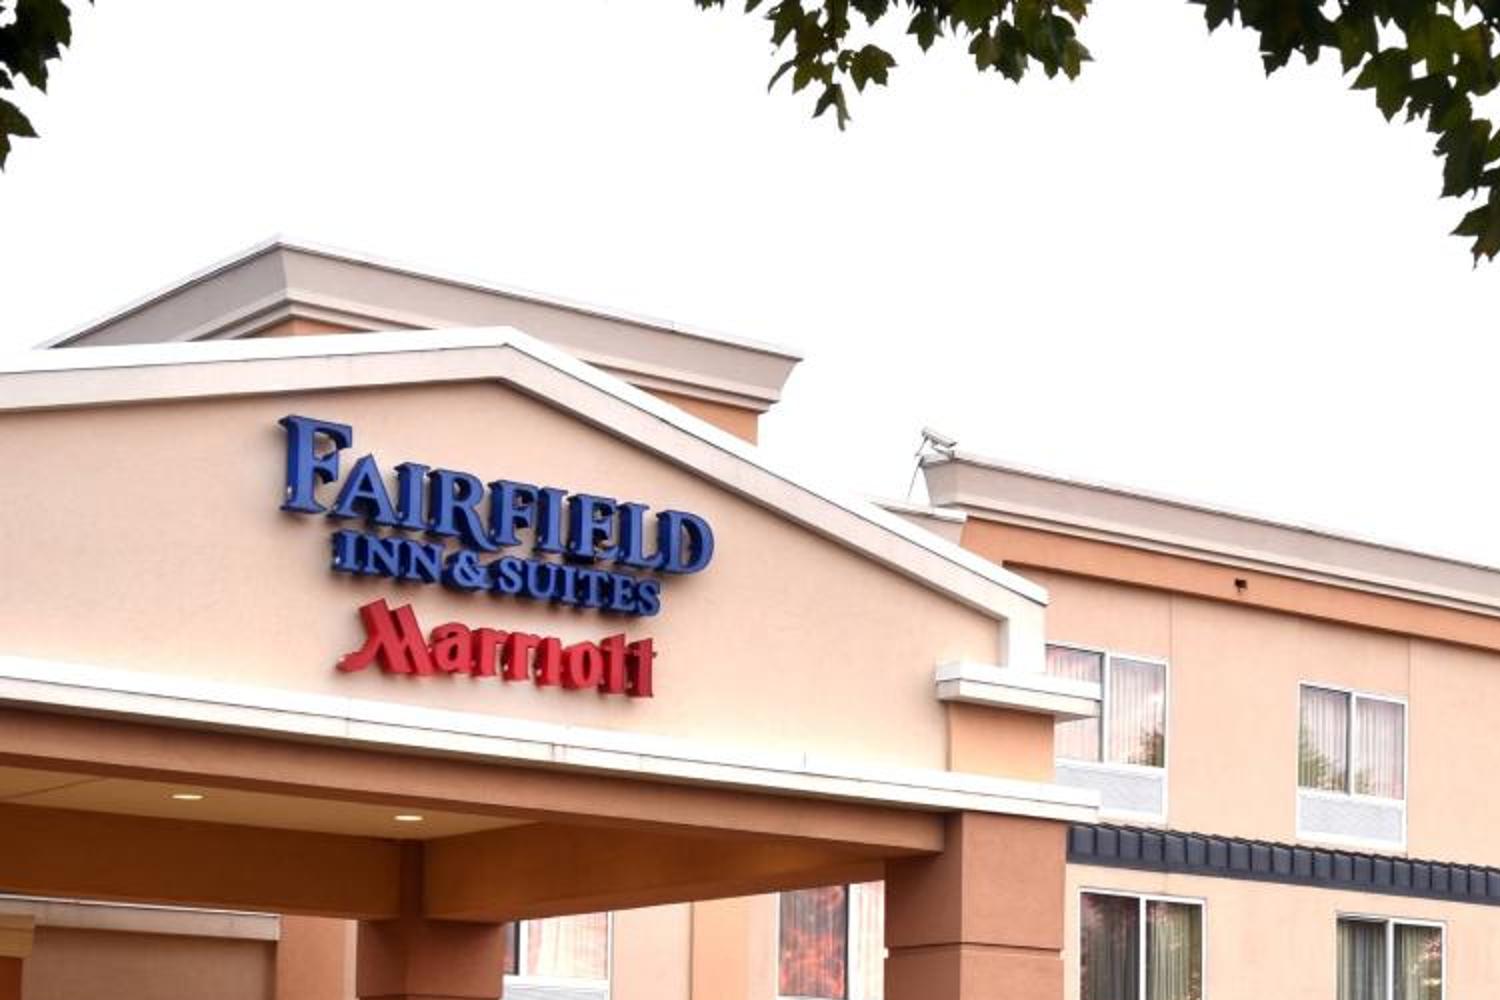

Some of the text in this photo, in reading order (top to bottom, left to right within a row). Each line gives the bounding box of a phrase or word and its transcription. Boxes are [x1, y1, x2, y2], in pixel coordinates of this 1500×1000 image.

[280, 415, 715, 574] FAIRFIELD
[332, 529, 663, 617] INN & SUITES
[335, 598, 657, 698] Marriott
